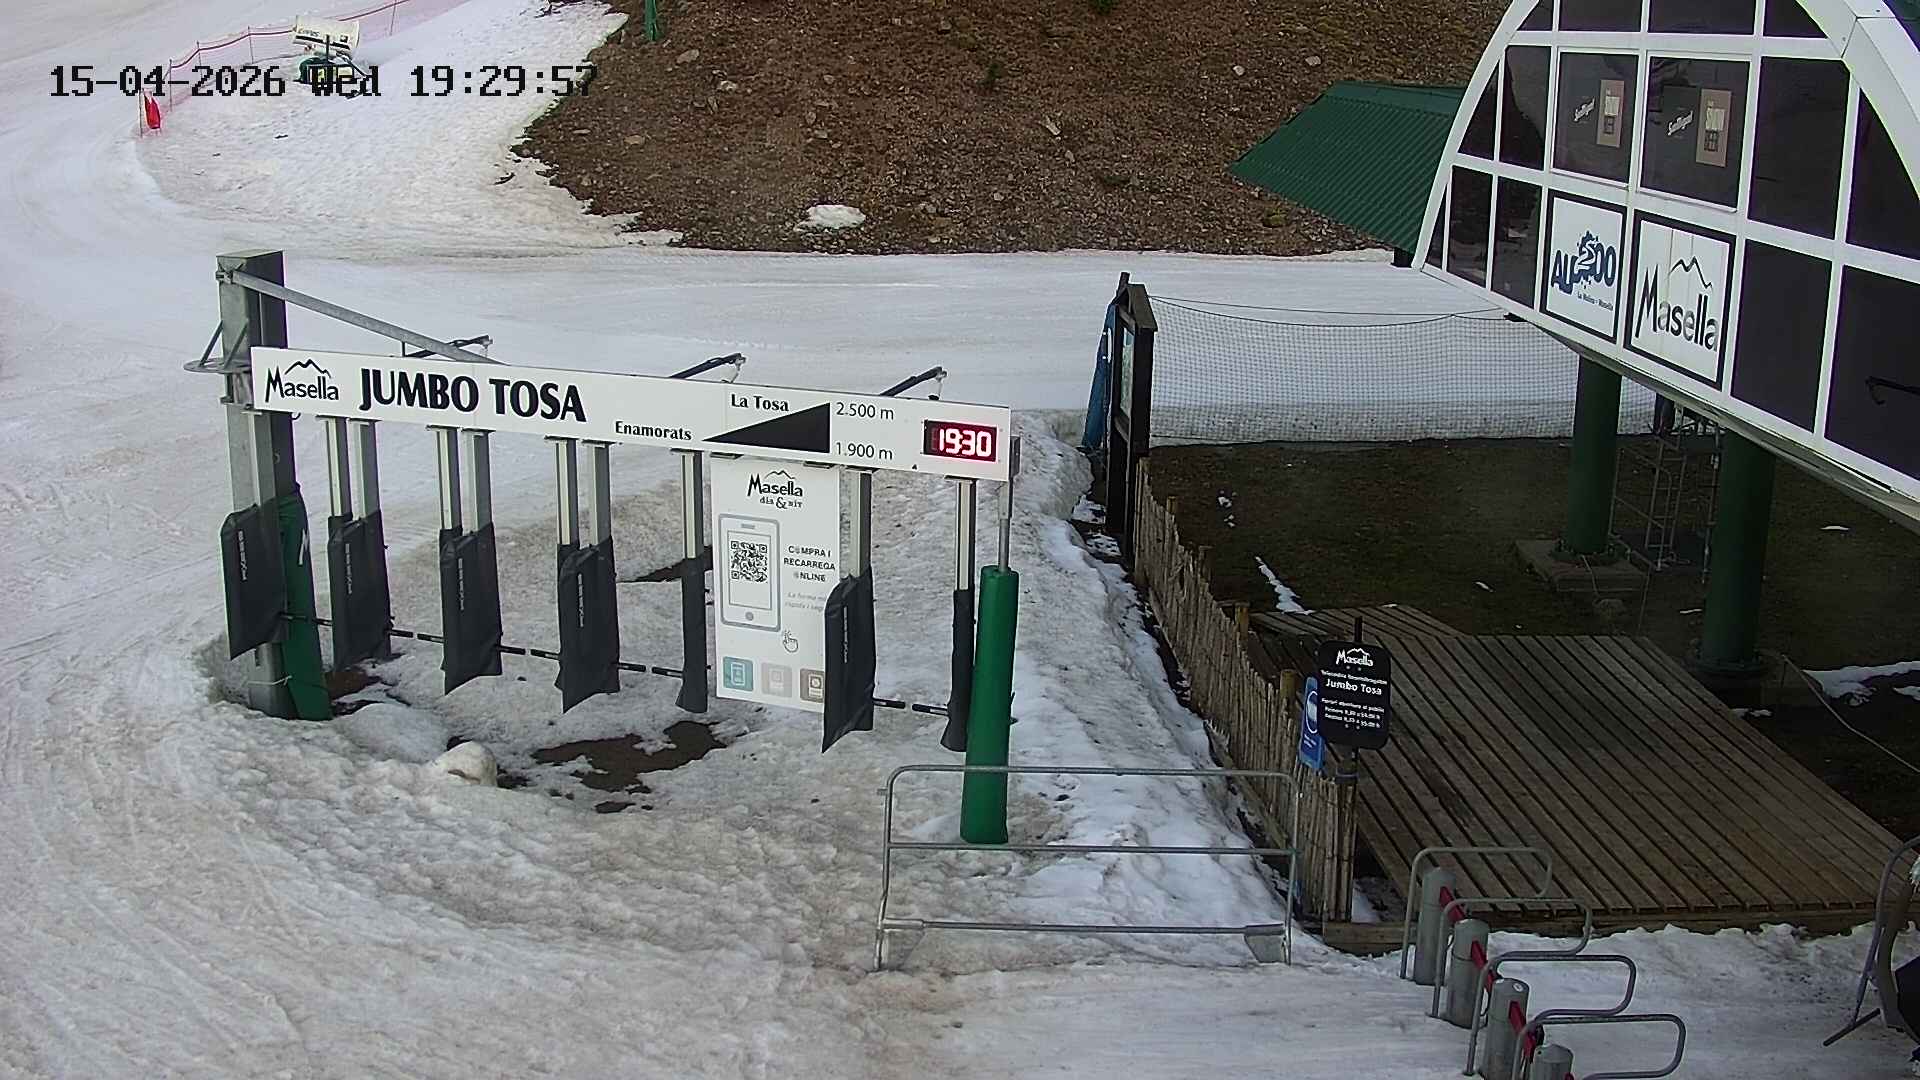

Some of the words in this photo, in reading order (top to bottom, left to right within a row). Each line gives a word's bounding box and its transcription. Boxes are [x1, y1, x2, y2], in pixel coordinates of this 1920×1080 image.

[1634, 263, 1718, 352] Masella
[265, 365, 339, 402] Masella
[359, 368, 479, 412] JUMBO
[488, 378, 587, 422] TOSA
[731, 393, 749, 409] La
[753, 395, 790, 412] Tosa
[836, 401, 876, 420] 2.500
[880, 408, 895, 420] m
[615, 420, 692, 441] Enamorats
[836, 442, 876, 459] 1.900
[878, 448, 893, 460] m
[747, 473, 803, 497] Masella
[775, 497, 788, 509] &
[1335, 649, 1373, 666] Masella
[1326, 678, 1358, 691] Jumbo
[1360, 683, 1382, 695] Tosa
